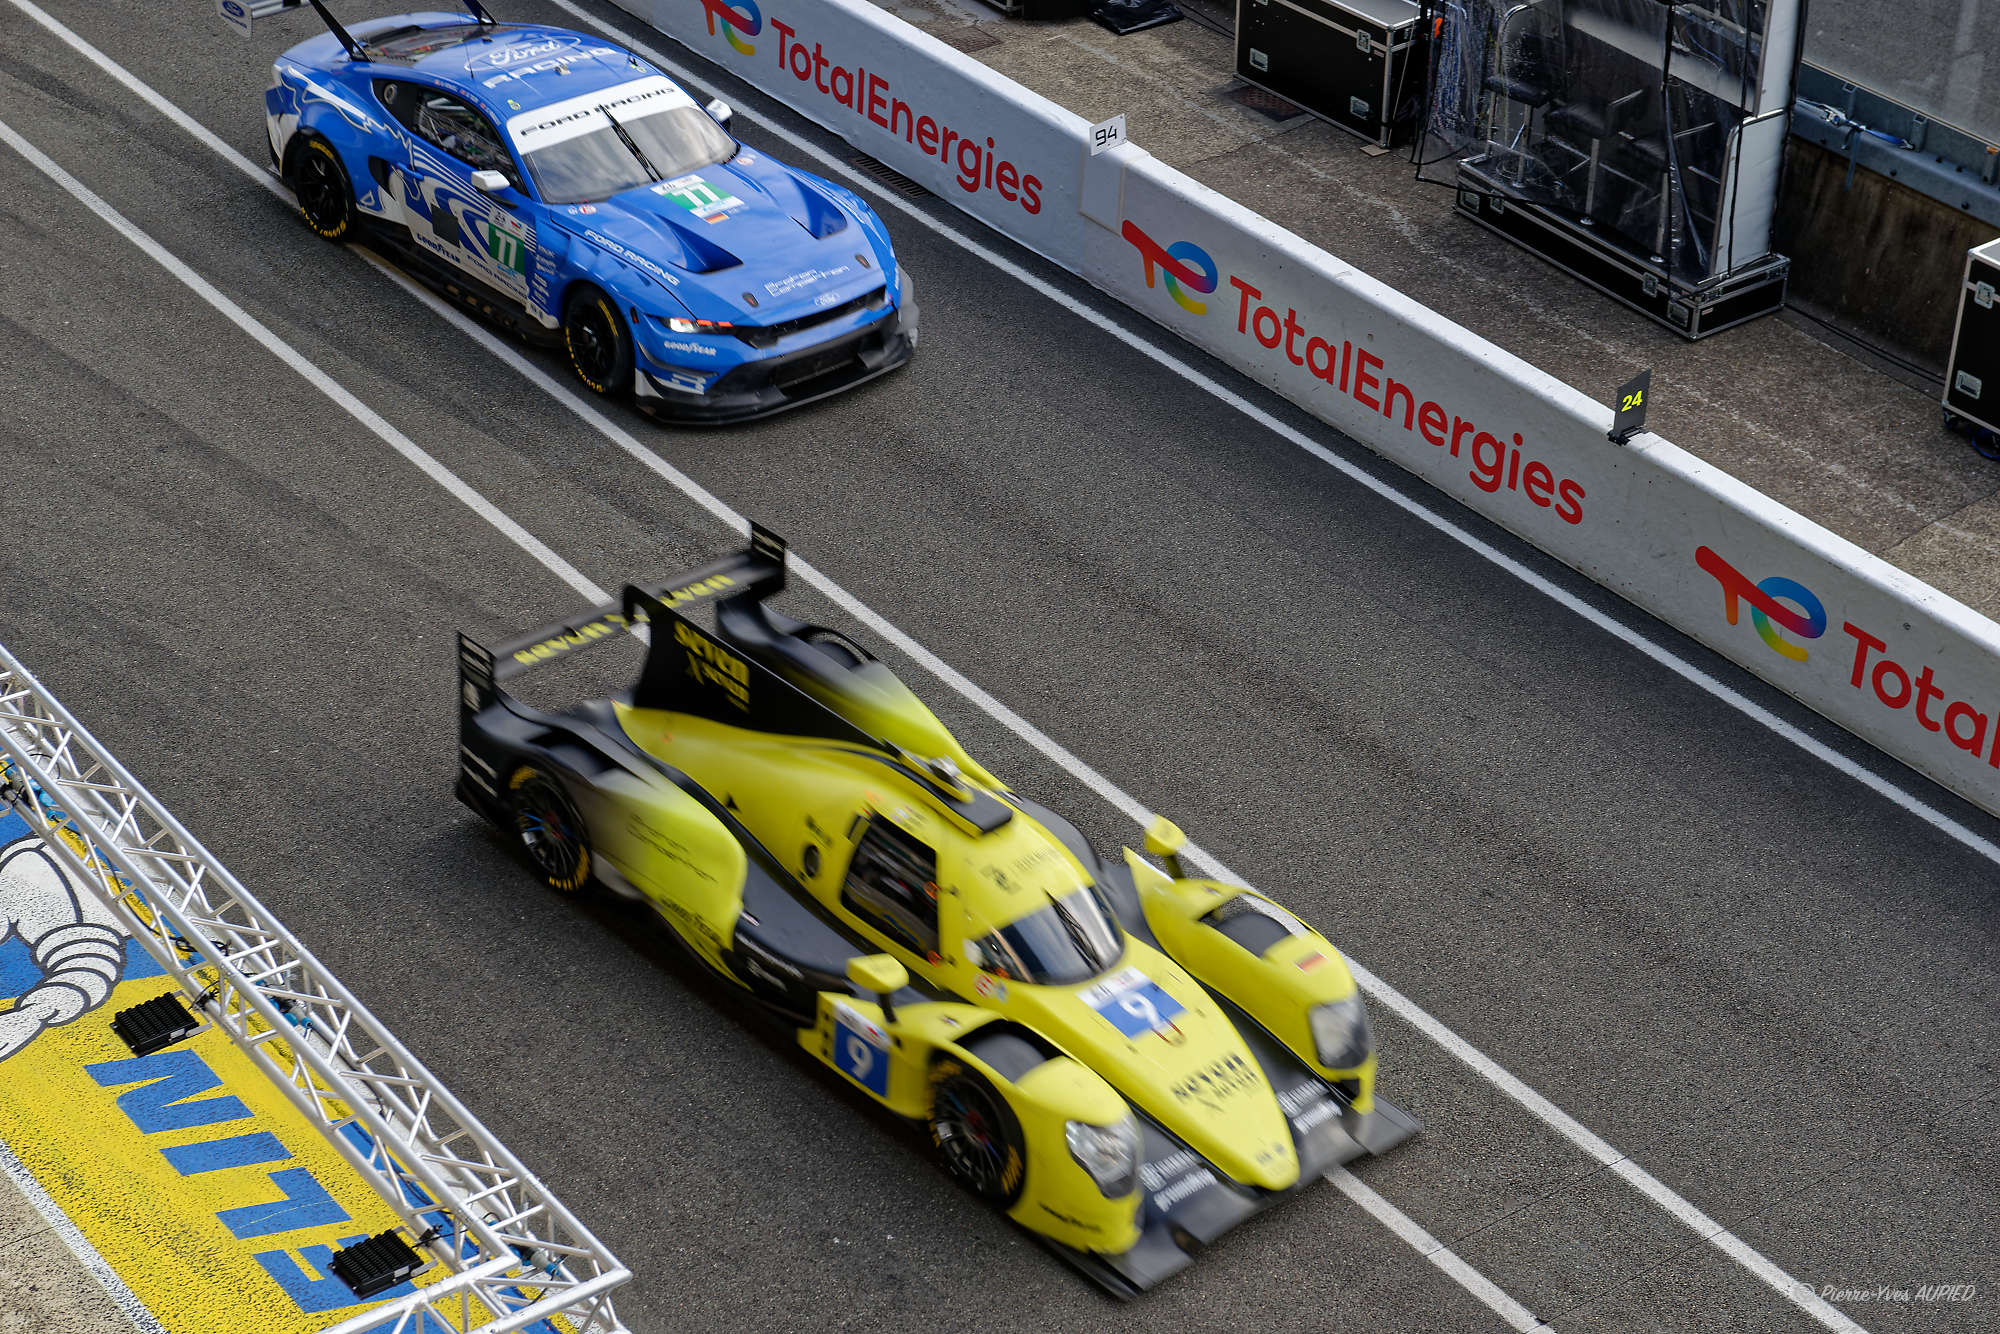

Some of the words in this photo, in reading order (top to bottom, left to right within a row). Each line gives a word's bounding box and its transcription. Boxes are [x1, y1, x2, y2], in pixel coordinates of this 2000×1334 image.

[489, 40, 560, 65] Ford
[520, 110, 590, 136] FORD
[771, 17, 1042, 215] TotalEnergies
[1095, 125, 1117, 147] 94
[671, 182, 721, 208] 77
[495, 228, 517, 272] 77
[584, 229, 623, 254] FORD
[623, 250, 680, 286] RACING
[1230, 275, 1586, 525] TotalEnergies
[1621, 390, 1643, 412] 24
[1118, 990, 1161, 1031] 9
[847, 1034, 874, 1081] 9
